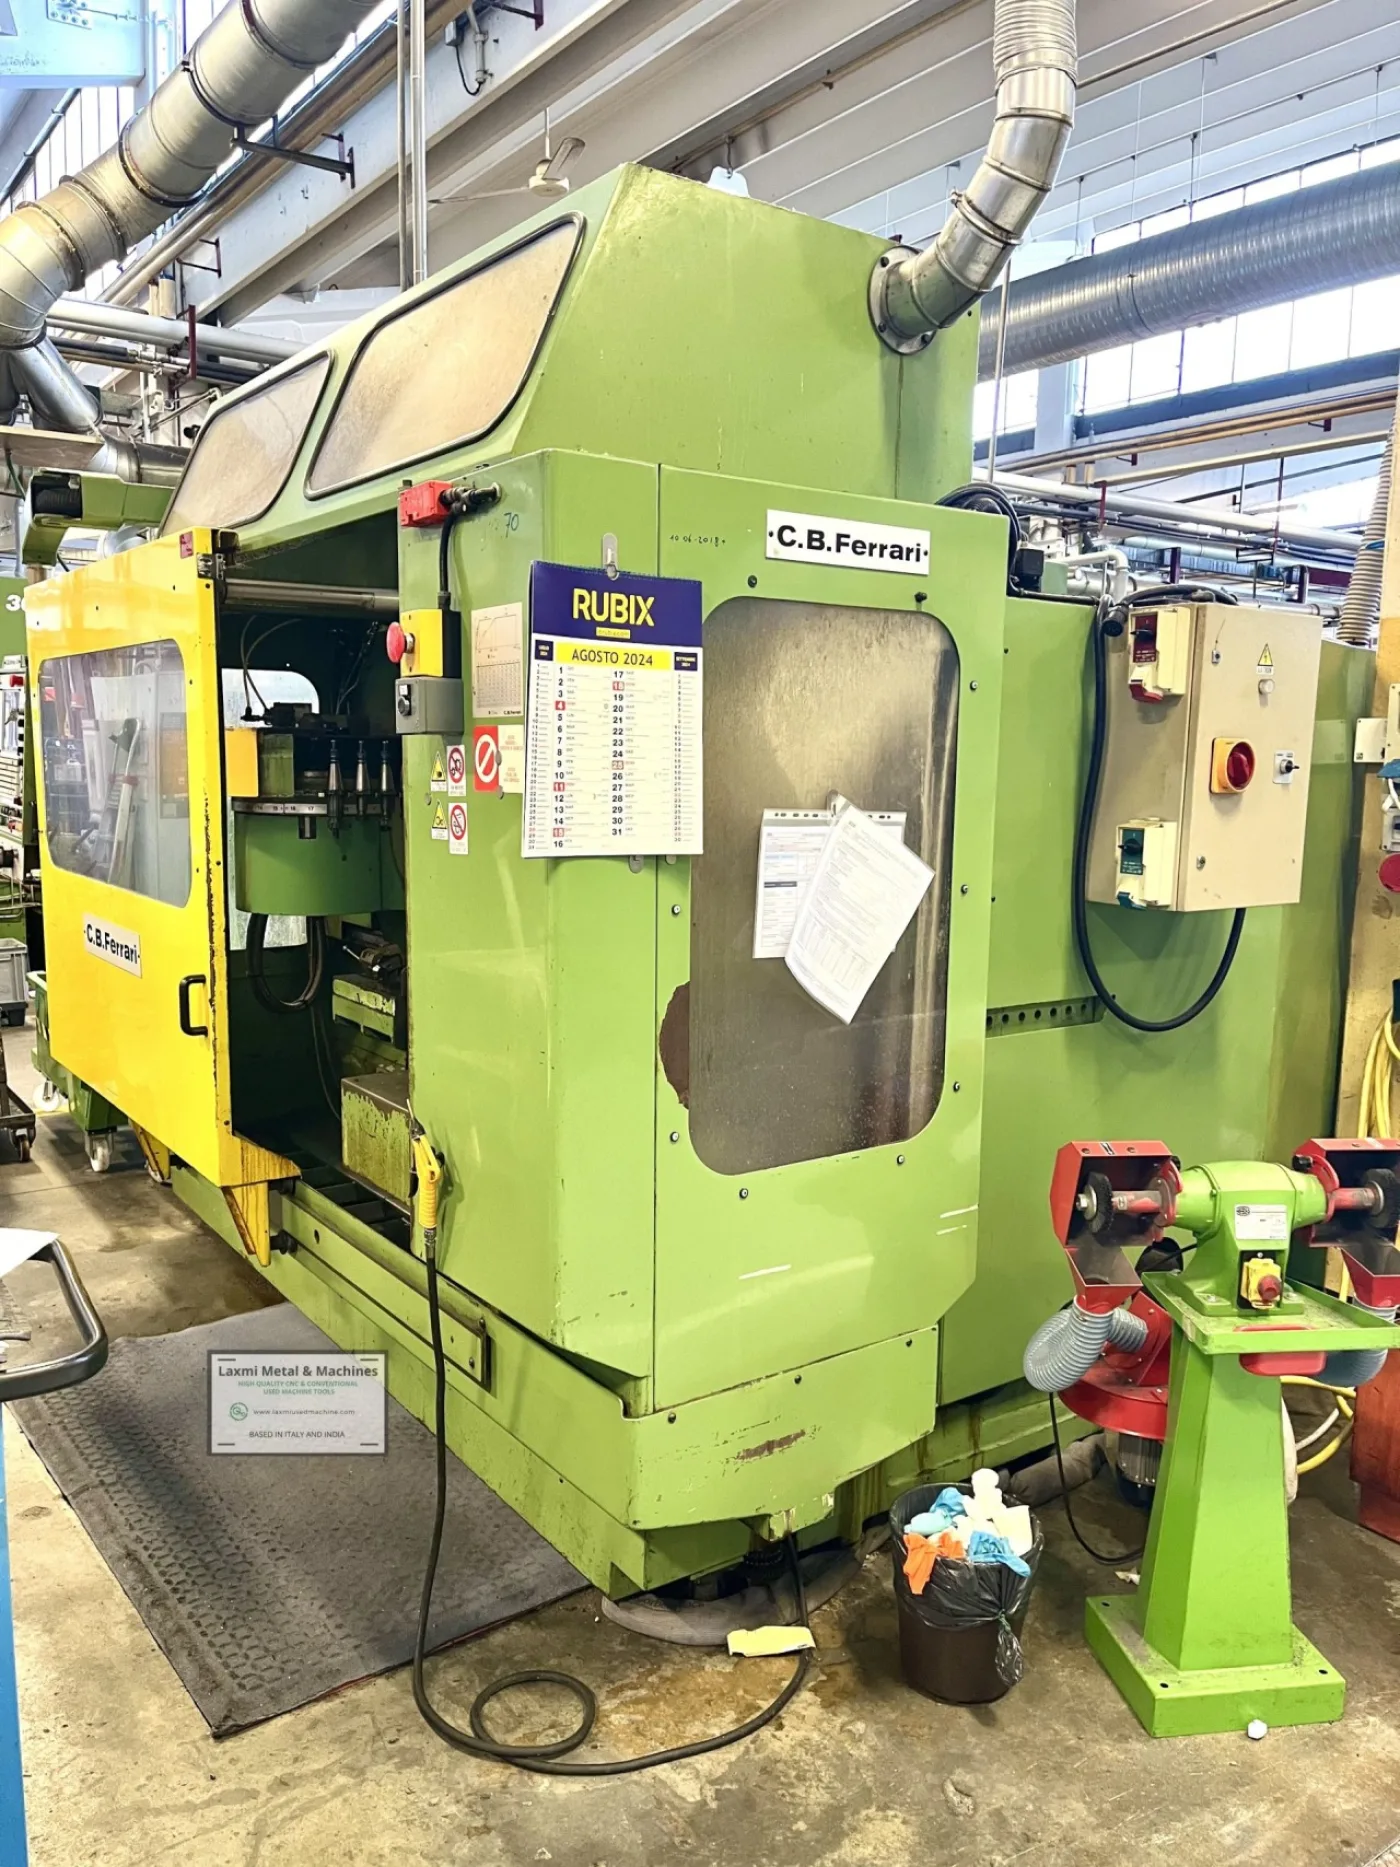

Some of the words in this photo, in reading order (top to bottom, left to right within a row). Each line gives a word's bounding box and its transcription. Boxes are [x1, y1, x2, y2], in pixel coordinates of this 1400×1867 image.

[504, 512, 519, 538] 70
[777, 524, 921, 562] C.B.Ferrari
[5, 594, 25, 611] 3
[573, 587, 655, 627] RUBIX
[572, 648, 619, 664] AGOSTO
[623, 652, 653, 667] 2024
[559, 666, 563, 674] 1
[558, 678, 563, 686] 2
[613, 682, 624, 690] 18
[558, 690, 563, 698] 3
[558, 713, 563, 721] 5
[558, 725, 562, 733] 6
[557, 760, 562, 768] 9
[612, 772, 623, 780] 26
[554, 782, 564, 791] 11
[612, 783, 623, 791] 27
[555, 806, 564, 814] 13
[612, 806, 623, 814] 29
[612, 817, 623, 825] 30
[612, 828, 622, 836] 31
[87, 923, 138, 965] C.B.Ferrari
